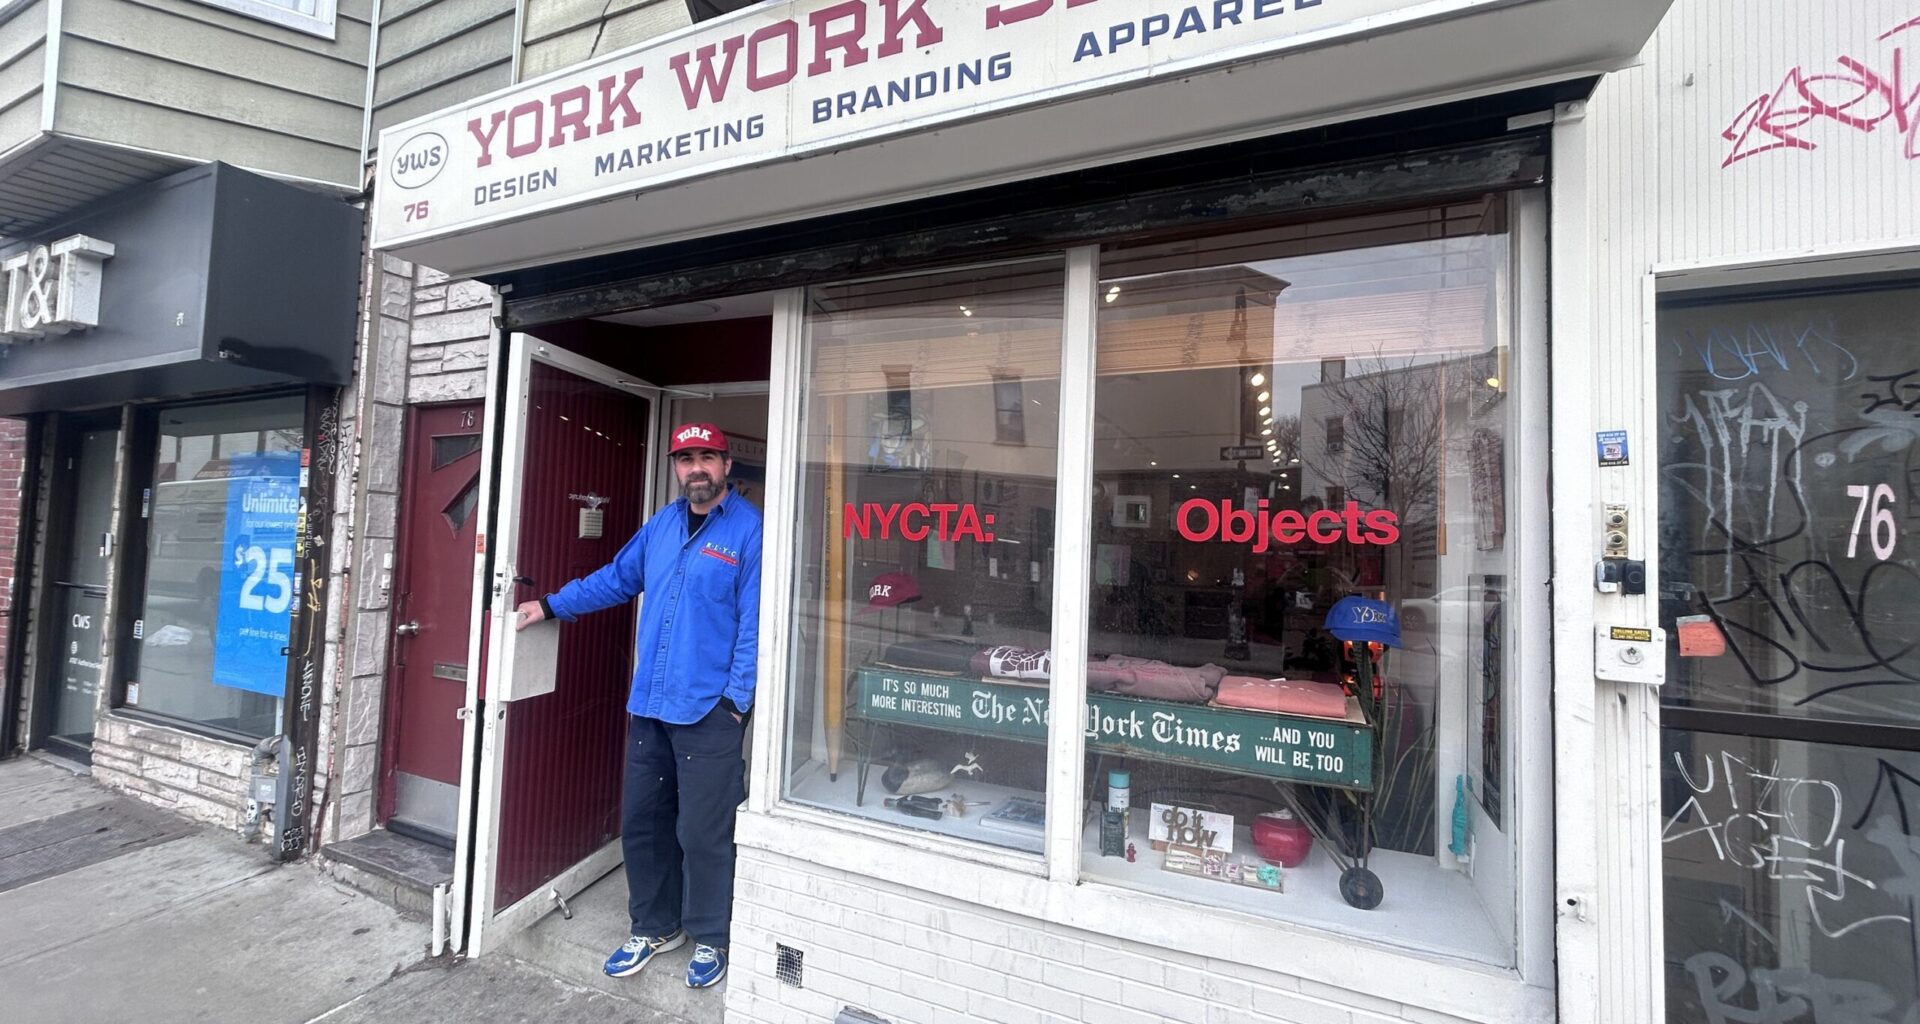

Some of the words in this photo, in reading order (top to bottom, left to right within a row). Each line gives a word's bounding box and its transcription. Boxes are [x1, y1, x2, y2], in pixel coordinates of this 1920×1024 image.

[467, 66, 645, 169] YORK
[668, 0, 944, 111] WORK
[474, 166, 558, 206] DESIGN
[594, 113, 765, 177] MARKETING
[812, 52, 1012, 124] BRANDING
[397, 145, 441, 174] YWS
[404, 200, 429, 222] 76
[677, 426, 712, 443] YORK
[843, 502, 995, 543] NYCTA:
[1176, 498, 1400, 553] Objects
[1846, 483, 1897, 561] 76
[72, 613, 91, 629] CWS
[883, 678, 899, 693] IT'S
[904, 681, 917, 694] SO
[921, 683, 949, 699] MUCH
[871, 694, 897, 711] MORE
[901, 698, 962, 719] INTERESTING
[972, 690, 1017, 724] The
[1151, 711, 1241, 753] Times
[1308, 730, 1335, 749] YOU
[1255, 745, 1286, 765] WILL
